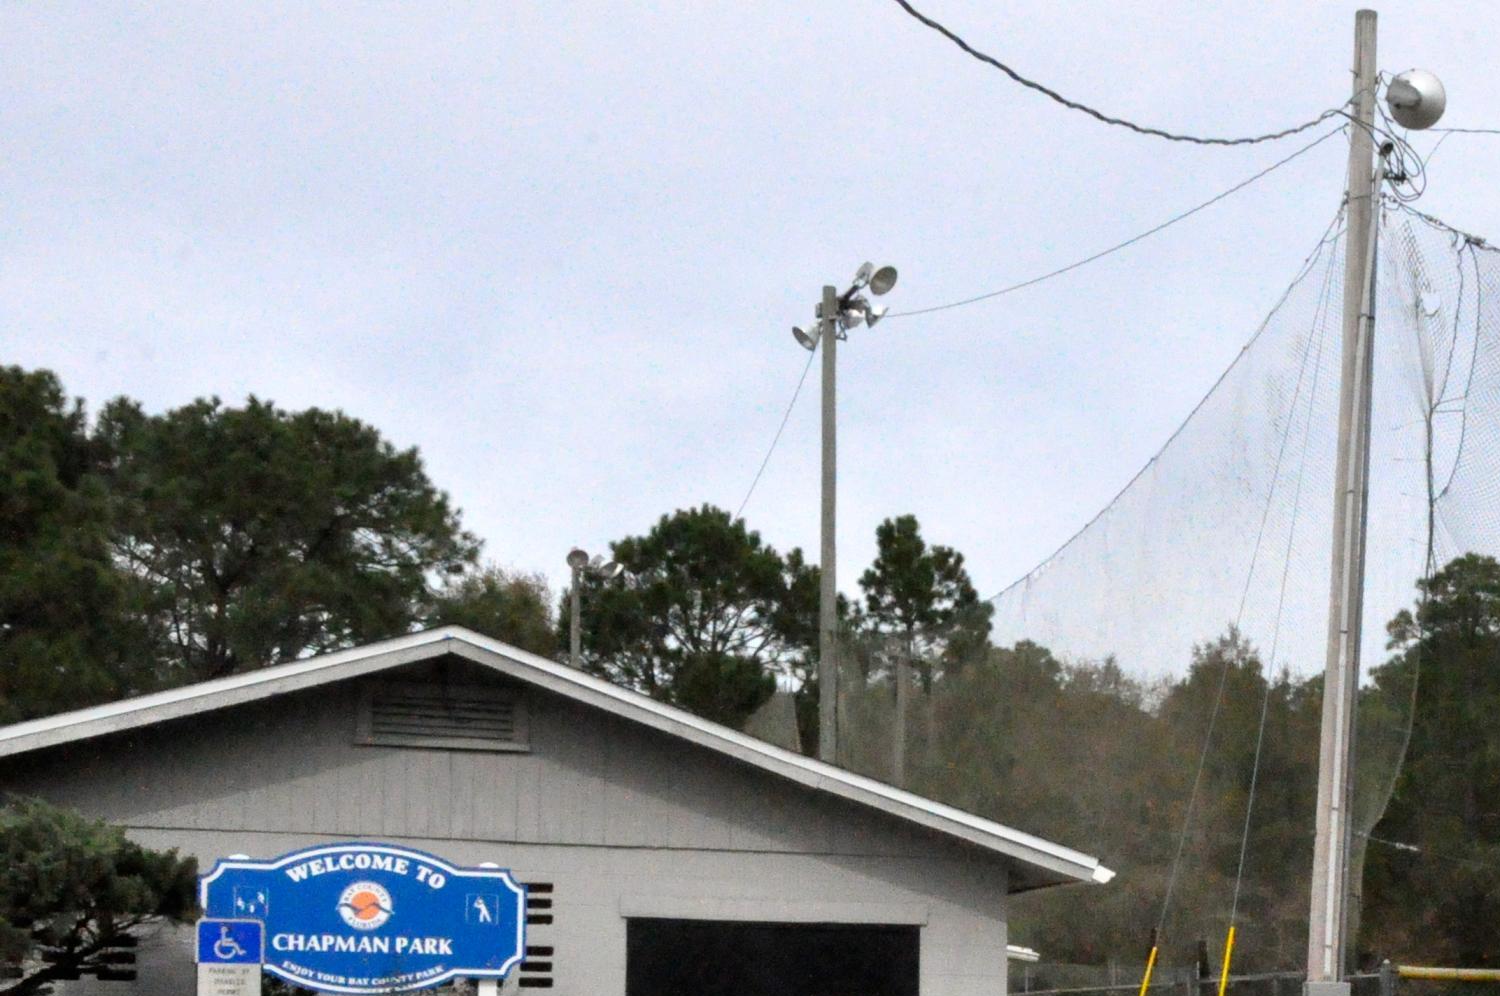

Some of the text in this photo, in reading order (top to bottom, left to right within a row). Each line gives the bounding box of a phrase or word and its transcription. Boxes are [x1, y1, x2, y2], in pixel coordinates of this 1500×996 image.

[285, 853, 446, 889] WELCOME TO
[272, 933, 454, 955] CHAPMAN PARK
[282, 960, 445, 986] ENJOY YOUR BAY COUNTY PARK
